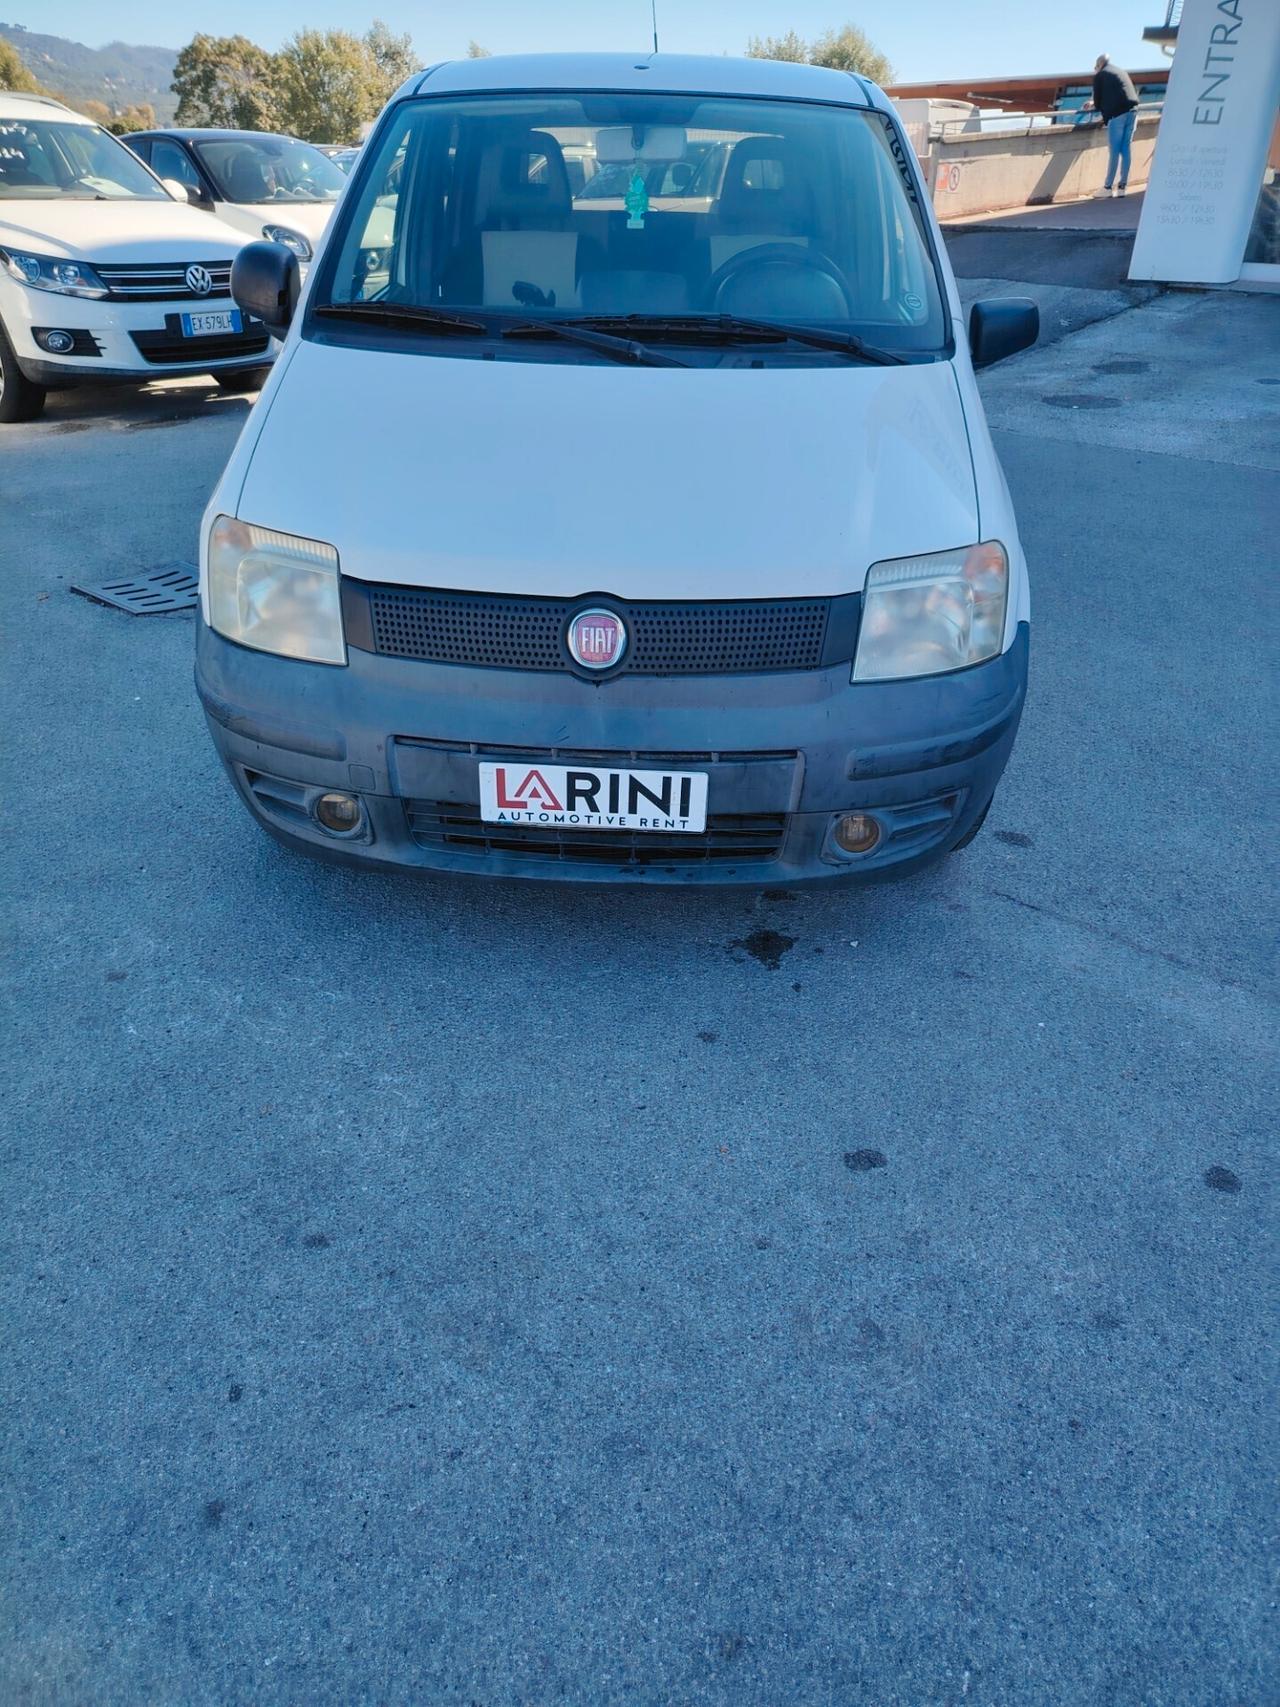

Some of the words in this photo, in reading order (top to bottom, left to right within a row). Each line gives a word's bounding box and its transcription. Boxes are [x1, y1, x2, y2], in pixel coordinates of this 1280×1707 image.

[191, 317, 203, 331] EX
[582, 626, 615, 654] FIAT
[495, 767, 692, 818] LARINI
[497, 811, 627, 826] AUTOMOTIVE
[639, 817, 690, 830] RENT
